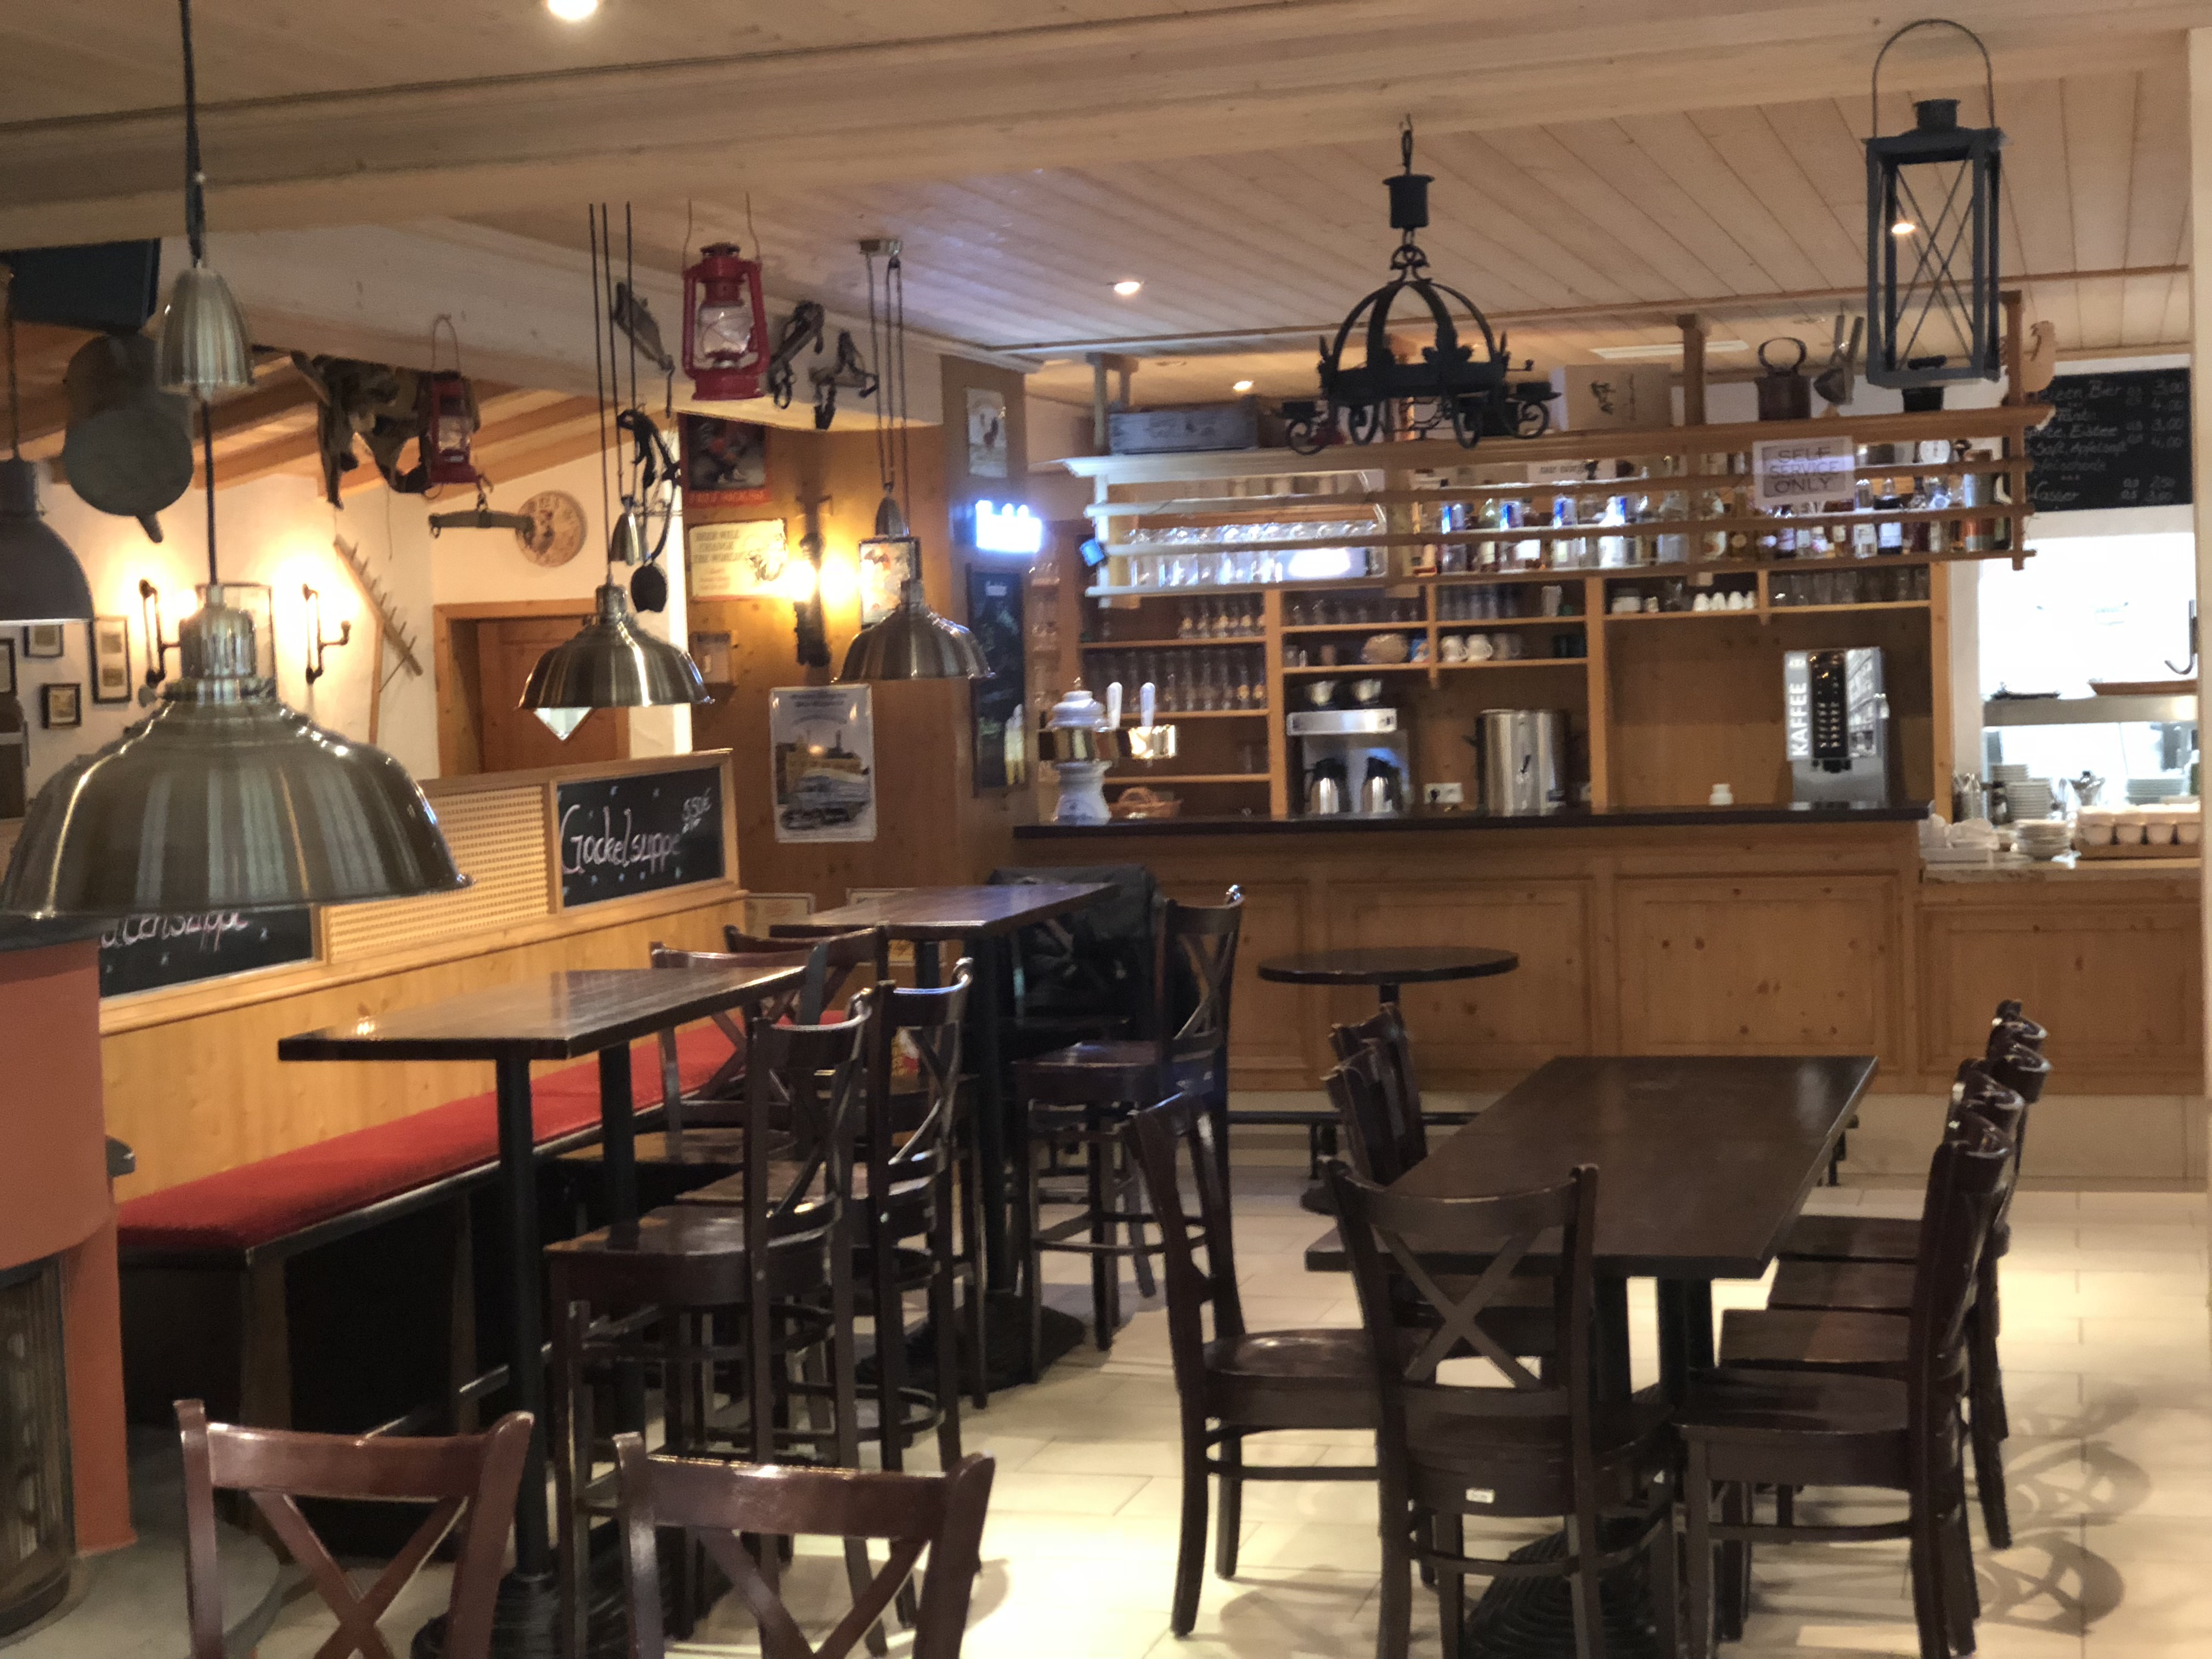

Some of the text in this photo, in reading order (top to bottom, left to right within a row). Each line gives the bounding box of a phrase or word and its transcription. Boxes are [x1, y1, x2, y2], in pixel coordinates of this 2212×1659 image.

[1779, 447, 1831, 462] SELF
[1770, 460, 1839, 478] SERVICE
[1775, 477, 1831, 494] ONLY
[1789, 682, 1809, 757] KAFFEE
[559, 804, 681, 874] Gockelsuppe
